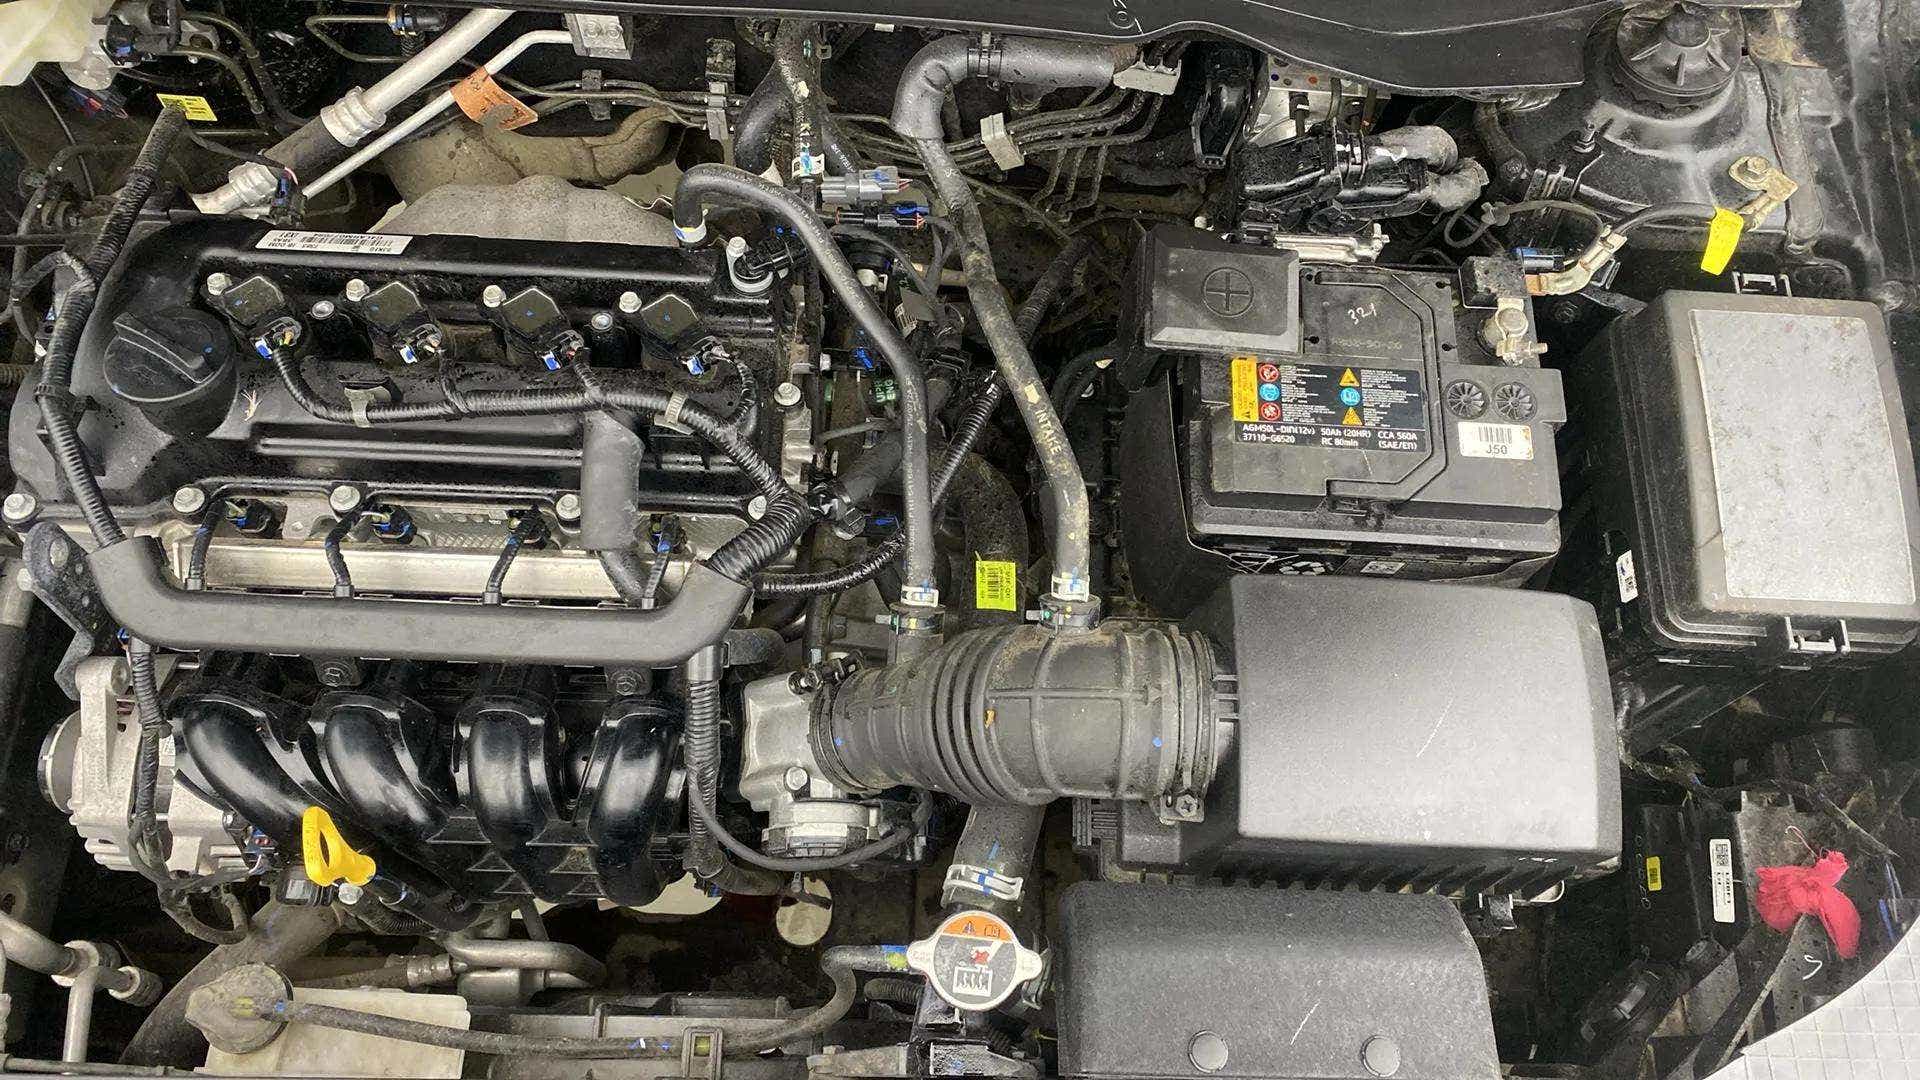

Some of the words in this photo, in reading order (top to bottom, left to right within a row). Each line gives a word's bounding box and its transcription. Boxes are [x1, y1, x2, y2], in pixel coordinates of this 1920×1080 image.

[1035, 408, 1061, 454] INTAKE
[1377, 430, 1395, 440] CCA
[1397, 432, 1418, 441] 560A
[1321, 437, 1333, 446] RC
[1334, 438, 1359, 447] 80min
[1486, 444, 1509, 455] J50
